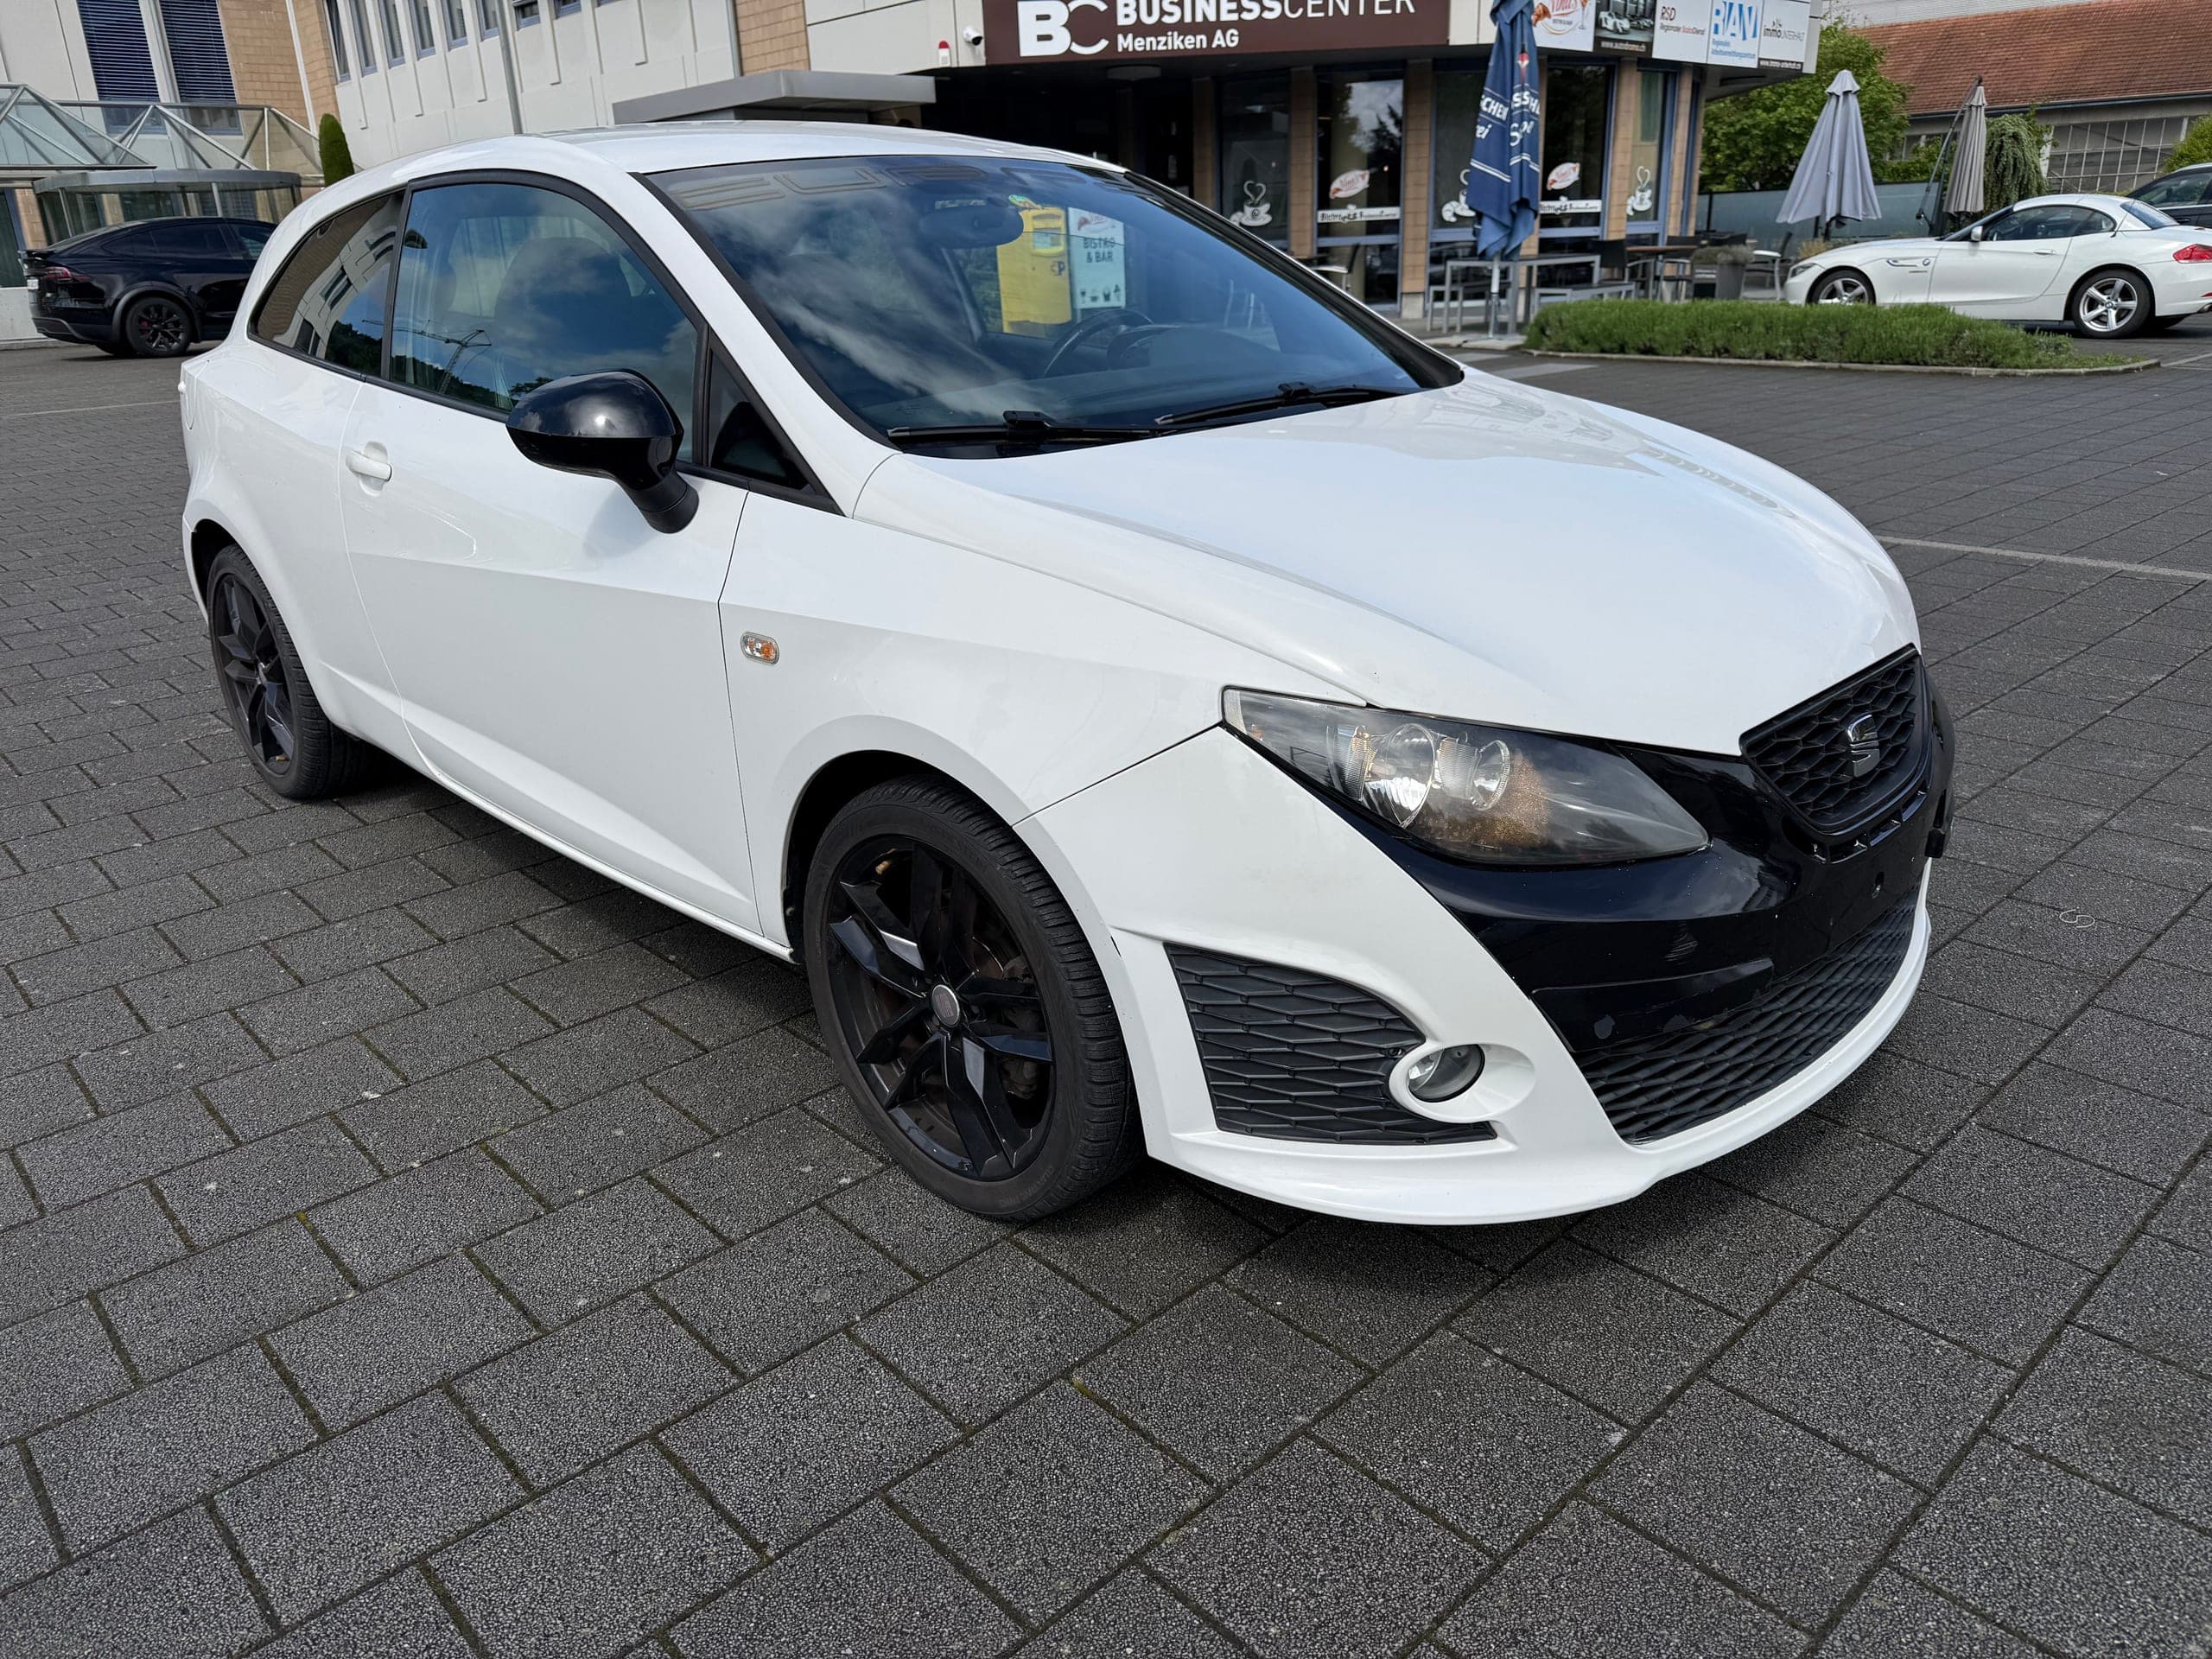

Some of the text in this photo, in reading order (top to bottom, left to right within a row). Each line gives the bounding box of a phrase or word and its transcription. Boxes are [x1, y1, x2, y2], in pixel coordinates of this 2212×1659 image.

[1117, 29, 1240, 53] Menziken AG
[1095, 251, 1114, 263] BAR
